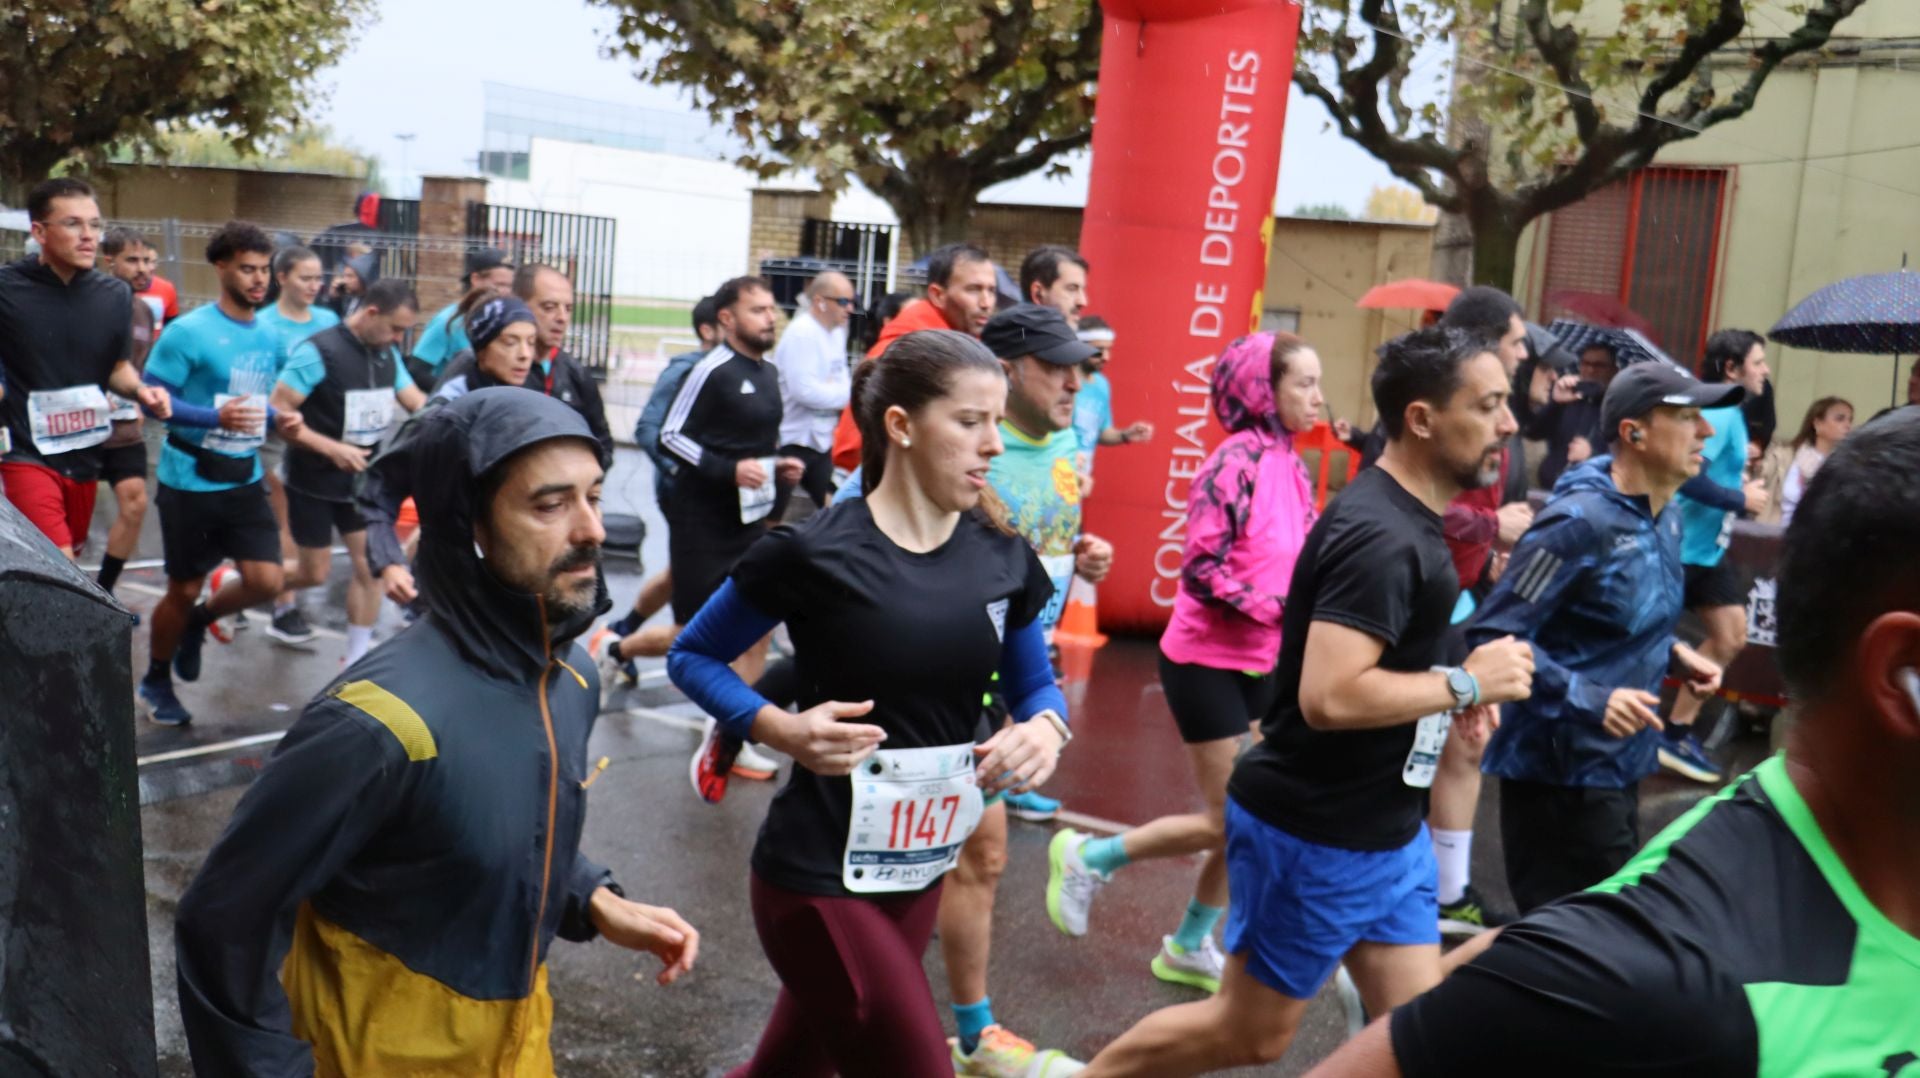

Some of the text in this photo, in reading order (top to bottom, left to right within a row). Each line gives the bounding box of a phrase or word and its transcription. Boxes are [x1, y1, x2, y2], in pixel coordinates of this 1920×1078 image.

[1150, 50, 1260, 608] CONCEJALÍA DE DEPORTES
[47, 408, 96, 436] 1080
[888, 795, 961, 849] 1147
